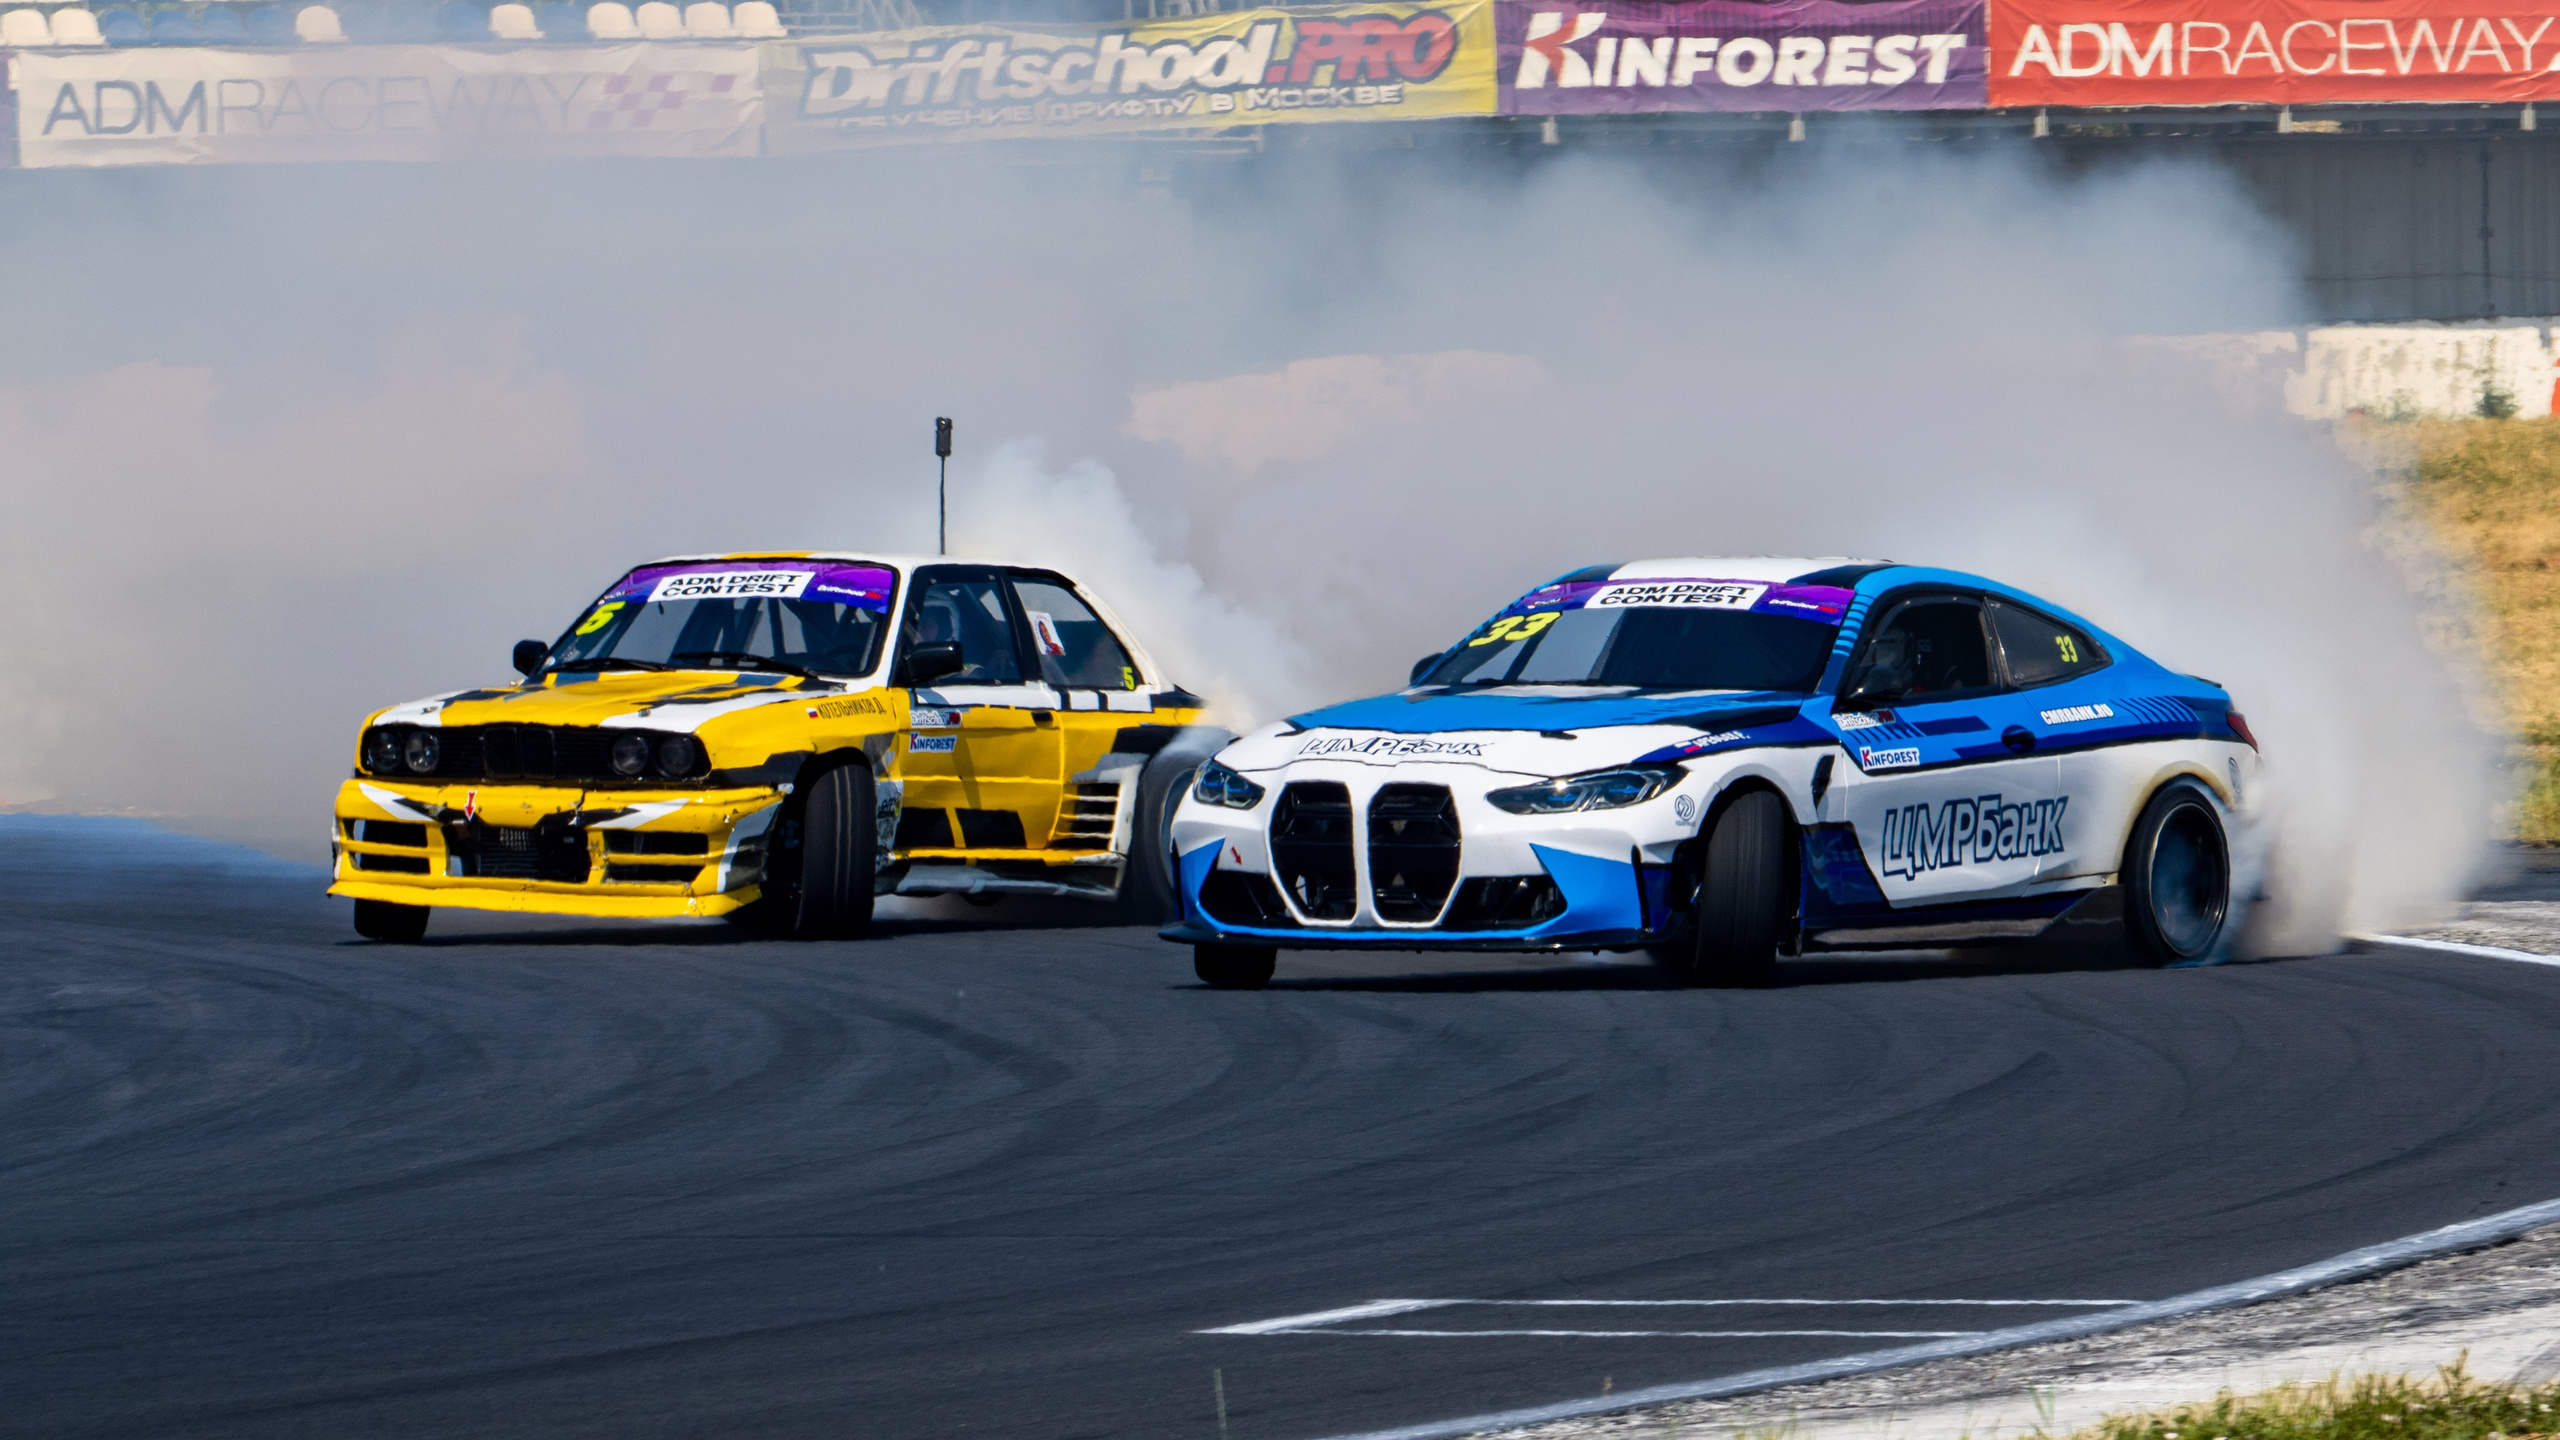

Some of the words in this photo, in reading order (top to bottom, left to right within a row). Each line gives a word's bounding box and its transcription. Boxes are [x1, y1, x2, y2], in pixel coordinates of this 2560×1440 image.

[1515, 12, 1967, 90] KINFOREST
[662, 584, 796, 597] CONTEST
[669, 576, 722, 587] ADM
[727, 574, 802, 585] DRIFT
[1608, 585, 1668, 596] ADM
[1671, 584, 1753, 596] DRIFT
[1600, 594, 1747, 605] CONTEST
[575, 601, 626, 636] 5
[1469, 611, 1563, 647] 33
[2055, 635, 2079, 663] 33
[1123, 667, 1136, 690] 5
[2040, 703, 2114, 726] CMRBANK.RU
[910, 732, 956, 750] KINFOREST
[1862, 749, 1918, 767] KINFOREST
[1882, 793, 2069, 881] ЦМРБанк
